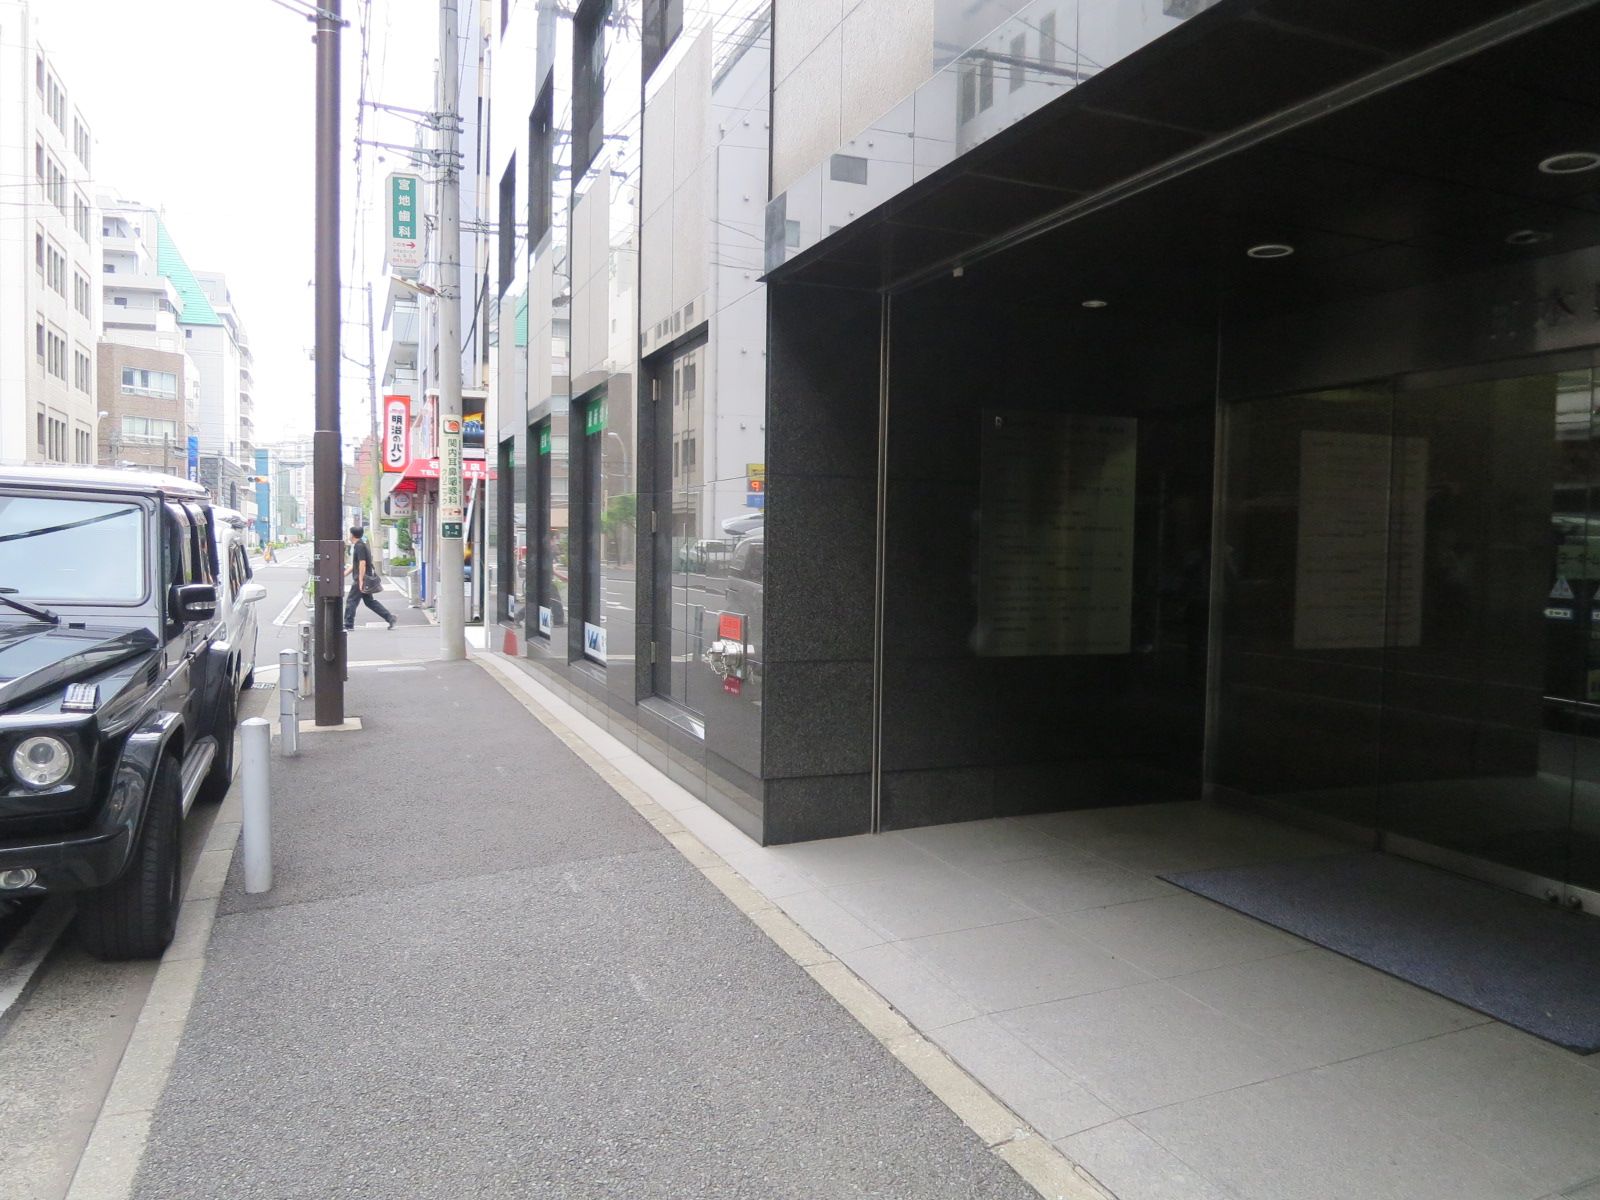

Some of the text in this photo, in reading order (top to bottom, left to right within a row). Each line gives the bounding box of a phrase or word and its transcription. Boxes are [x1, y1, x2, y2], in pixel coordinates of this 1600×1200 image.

[398, 180, 411, 237] 宮地歯科
[391, 415, 403, 462] 明治のパン
